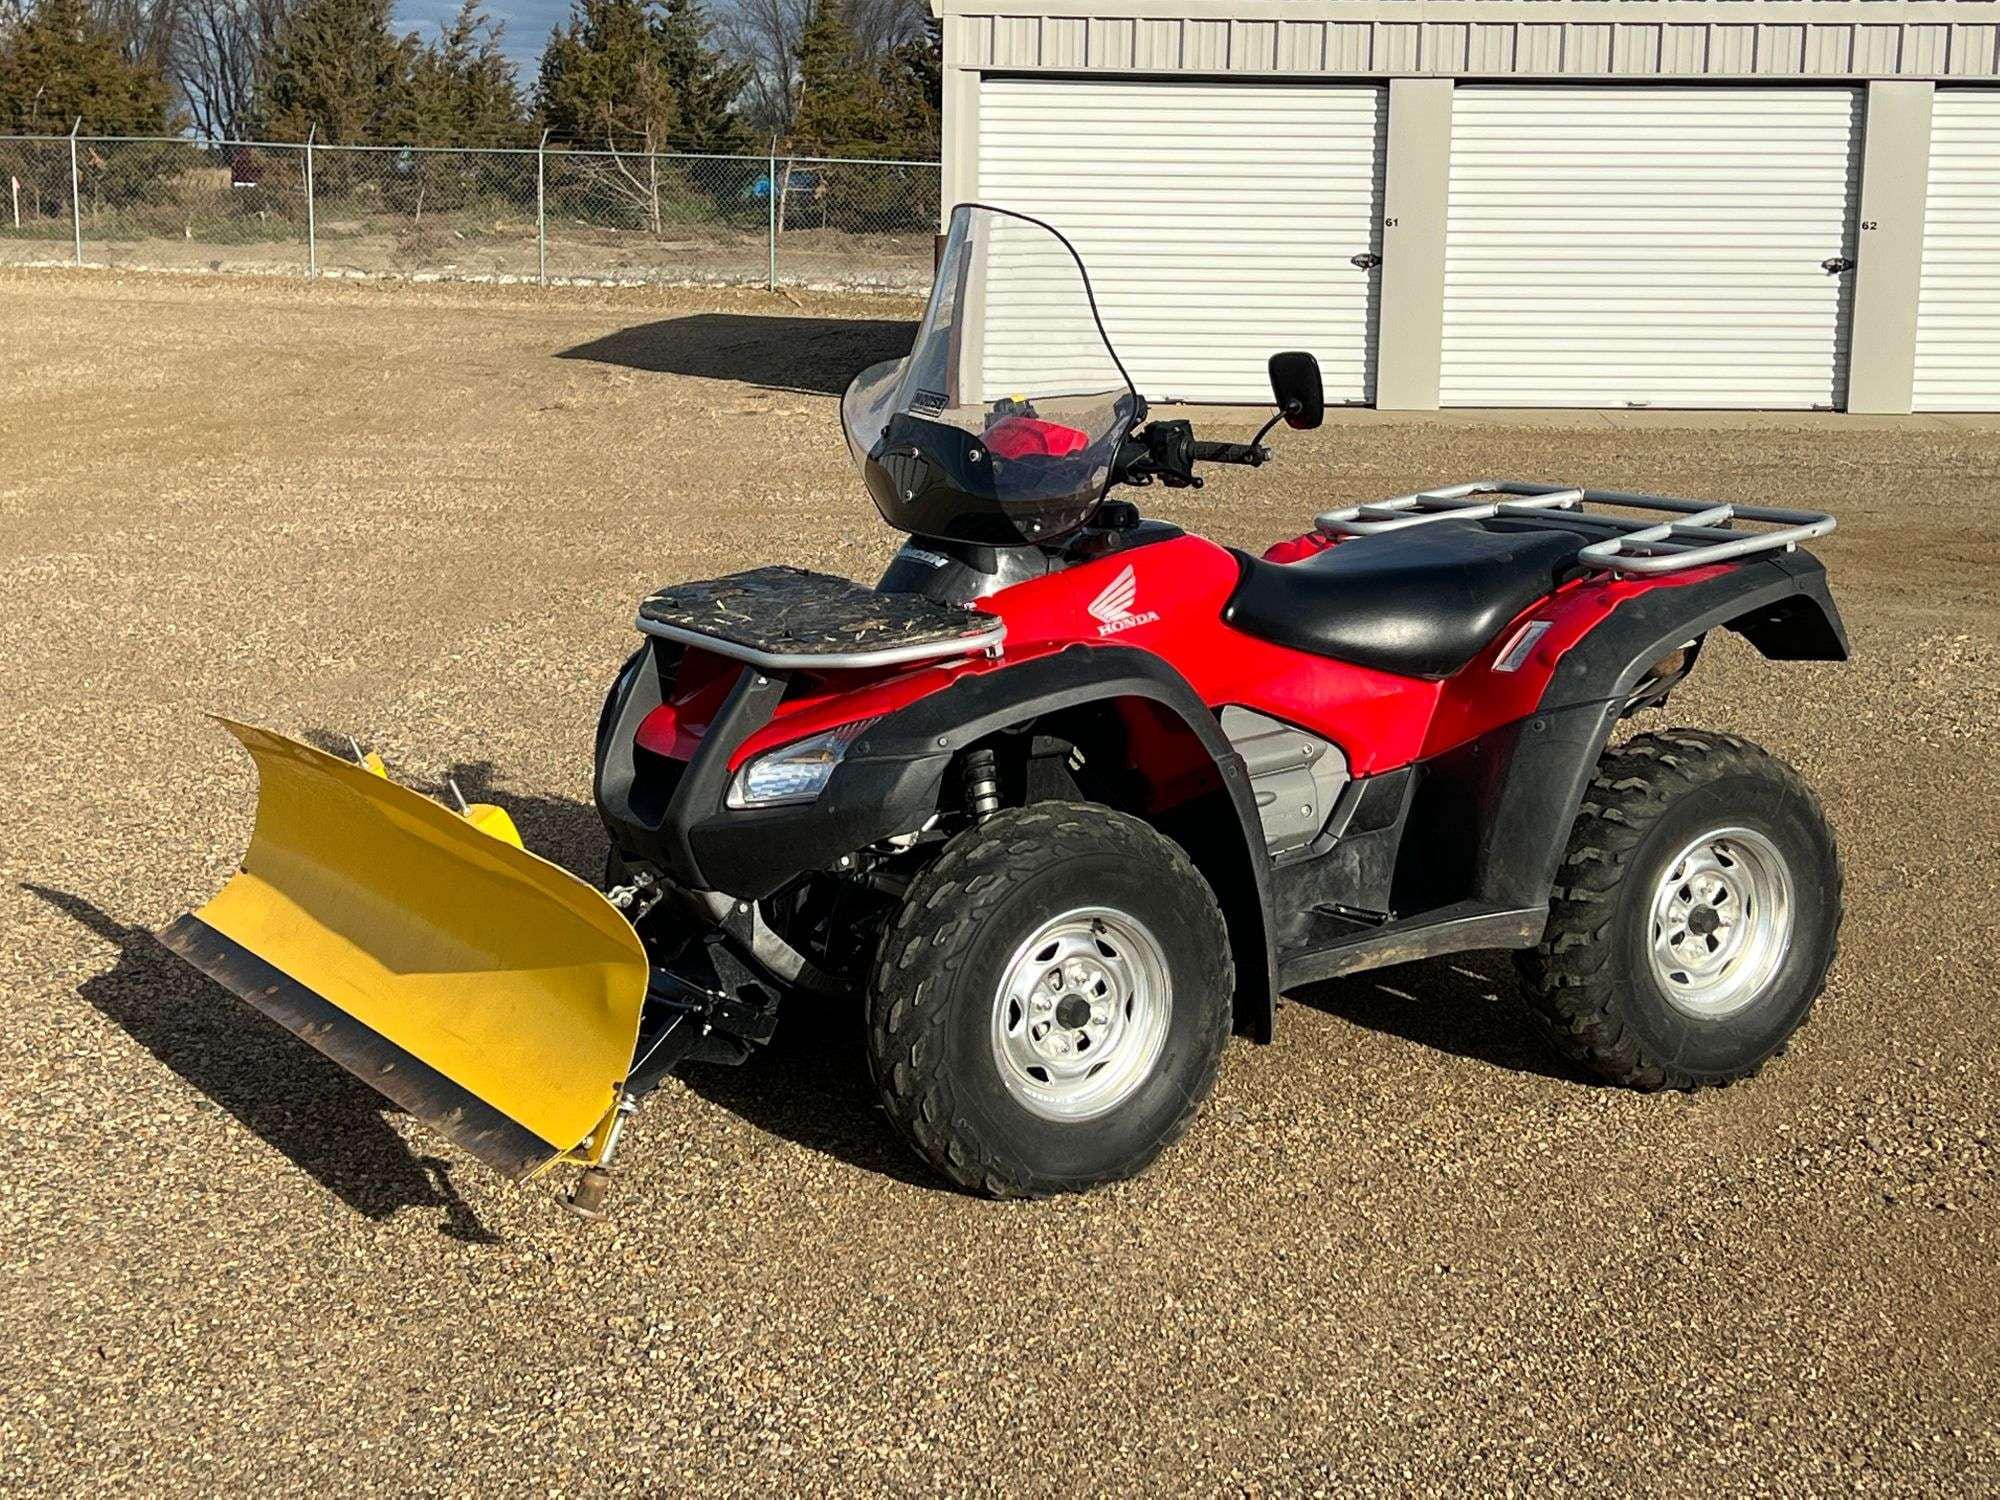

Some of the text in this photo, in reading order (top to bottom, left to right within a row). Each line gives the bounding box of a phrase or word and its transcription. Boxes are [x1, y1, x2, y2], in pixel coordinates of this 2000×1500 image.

[1385, 218, 1399, 227] 61
[1861, 221, 1878, 230] 62
[1097, 611, 1160, 637] HONDA
